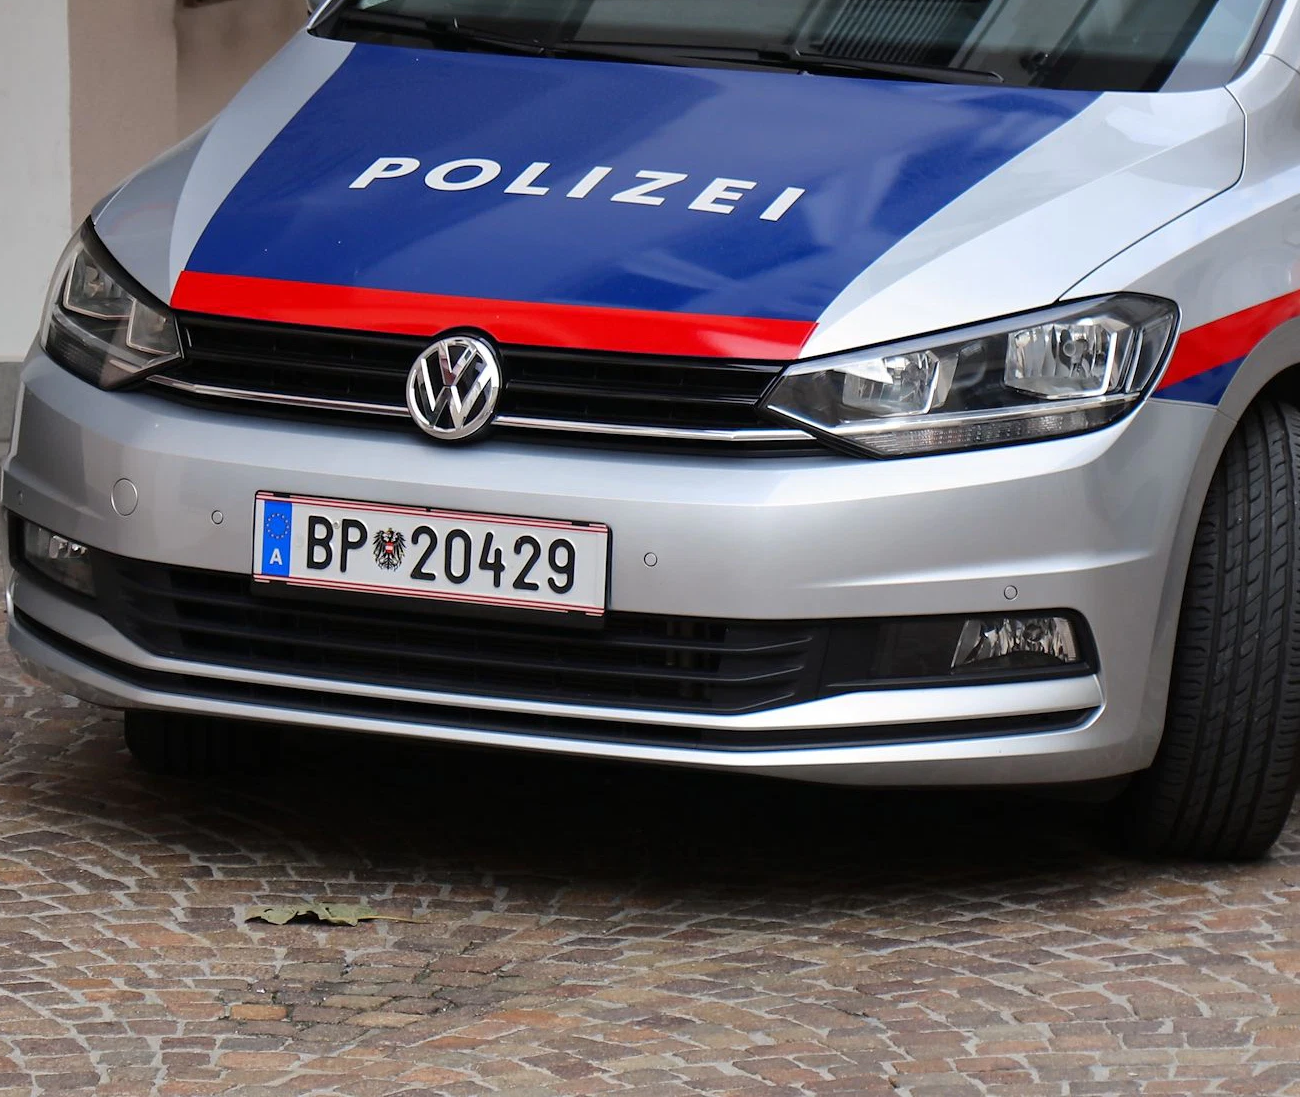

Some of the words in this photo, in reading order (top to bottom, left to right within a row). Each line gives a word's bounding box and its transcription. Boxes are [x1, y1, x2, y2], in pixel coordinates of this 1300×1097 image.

[348, 156, 807, 223] POLIZEI
[406, 337, 501, 439] VW
[268, 547, 284, 566] A
[306, 515, 368, 573] BP
[410, 525, 577, 595] 20429
